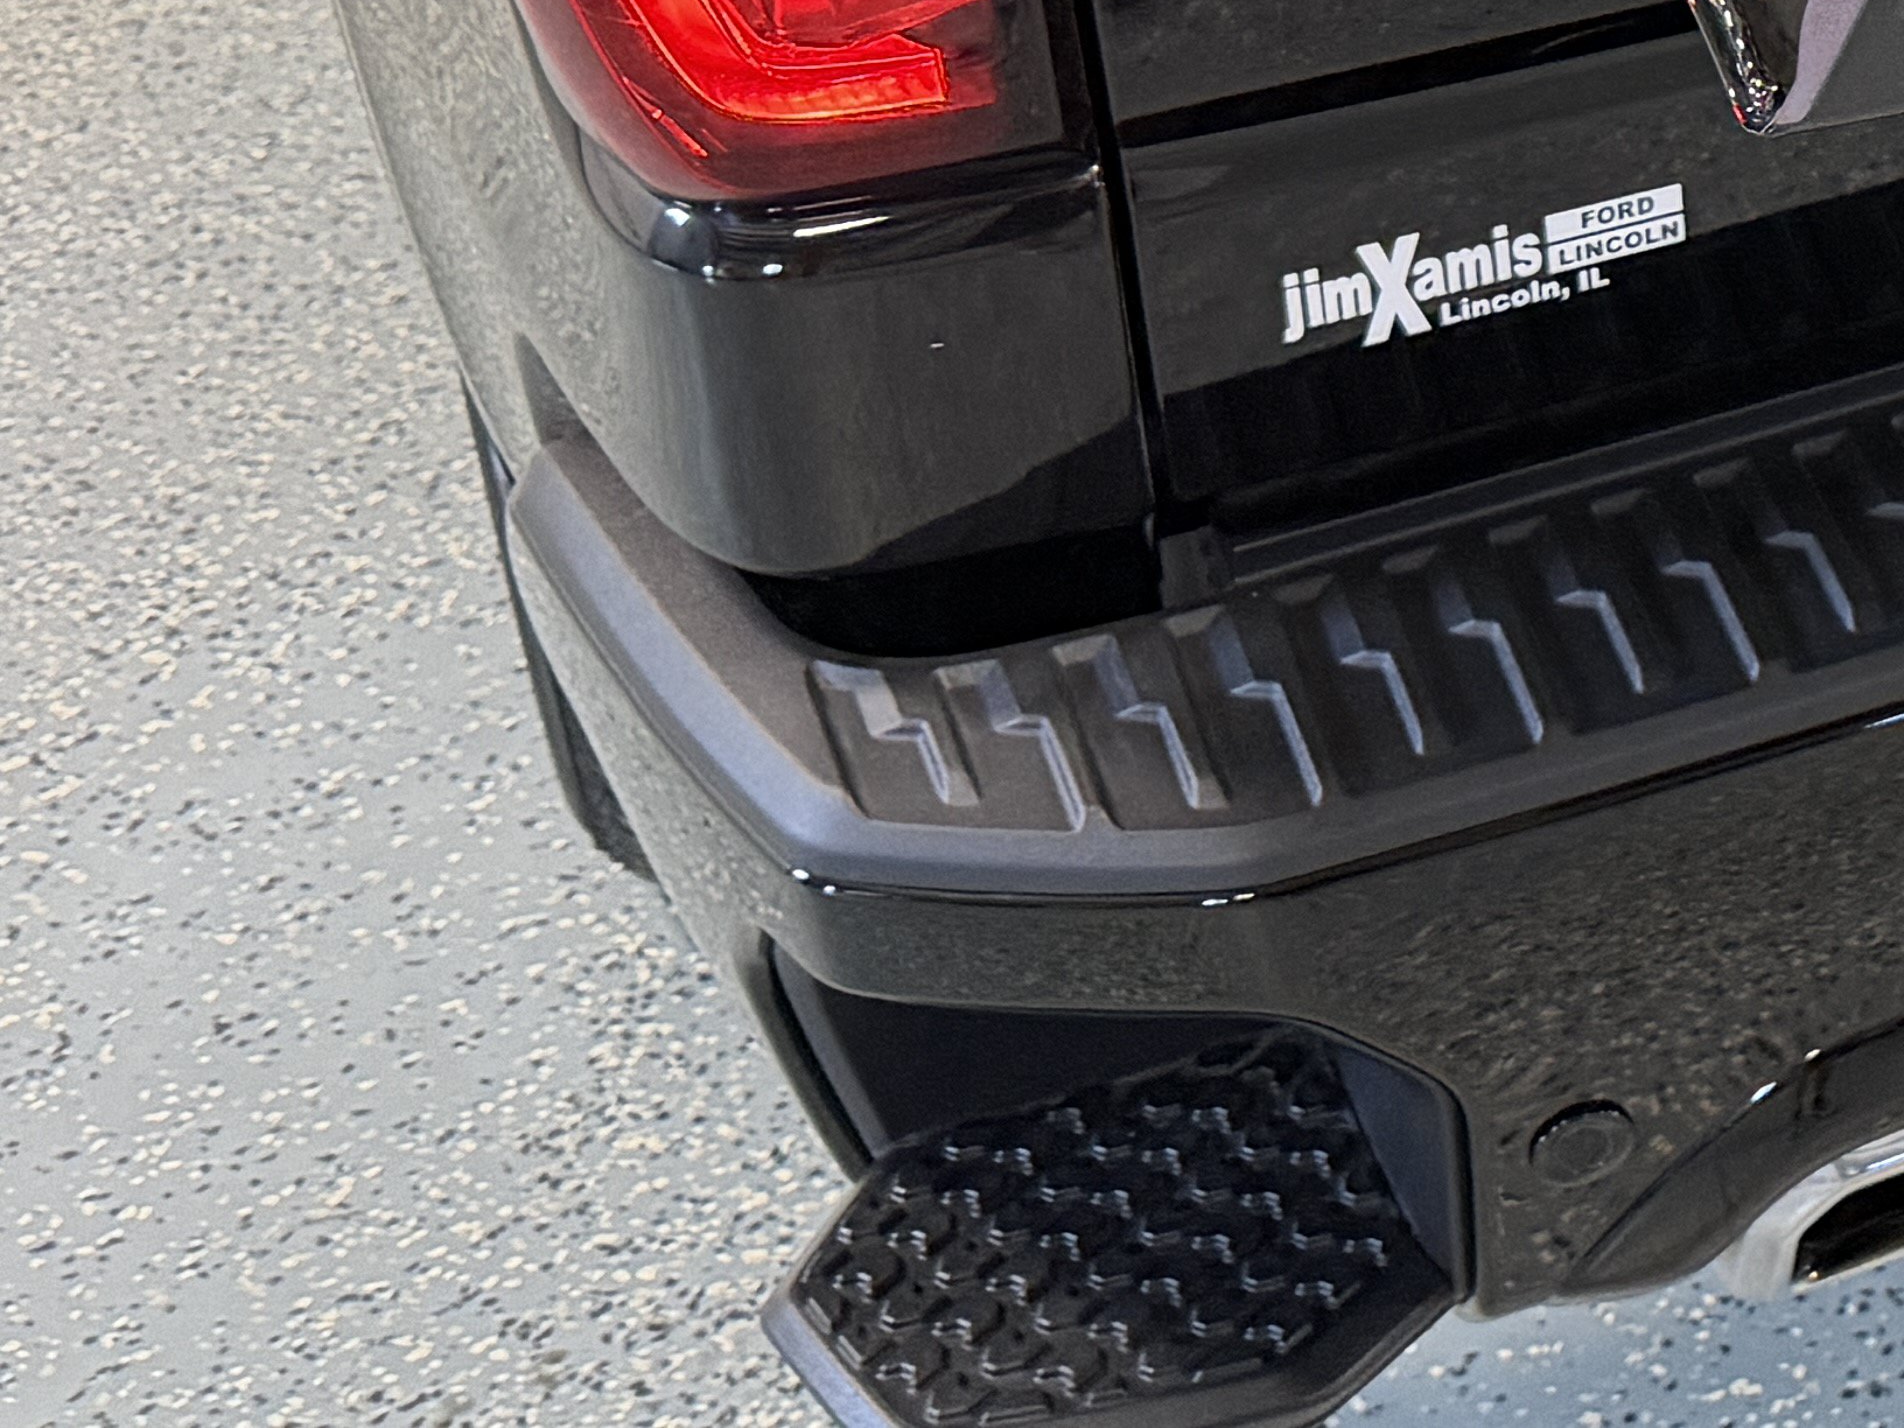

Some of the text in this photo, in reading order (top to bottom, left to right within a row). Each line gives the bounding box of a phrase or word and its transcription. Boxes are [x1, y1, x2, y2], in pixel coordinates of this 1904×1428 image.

[1580, 195, 1656, 230] FORD
[1557, 220, 1680, 267] LINCOLN
[1438, 266, 1611, 328] Lincoln, IL
